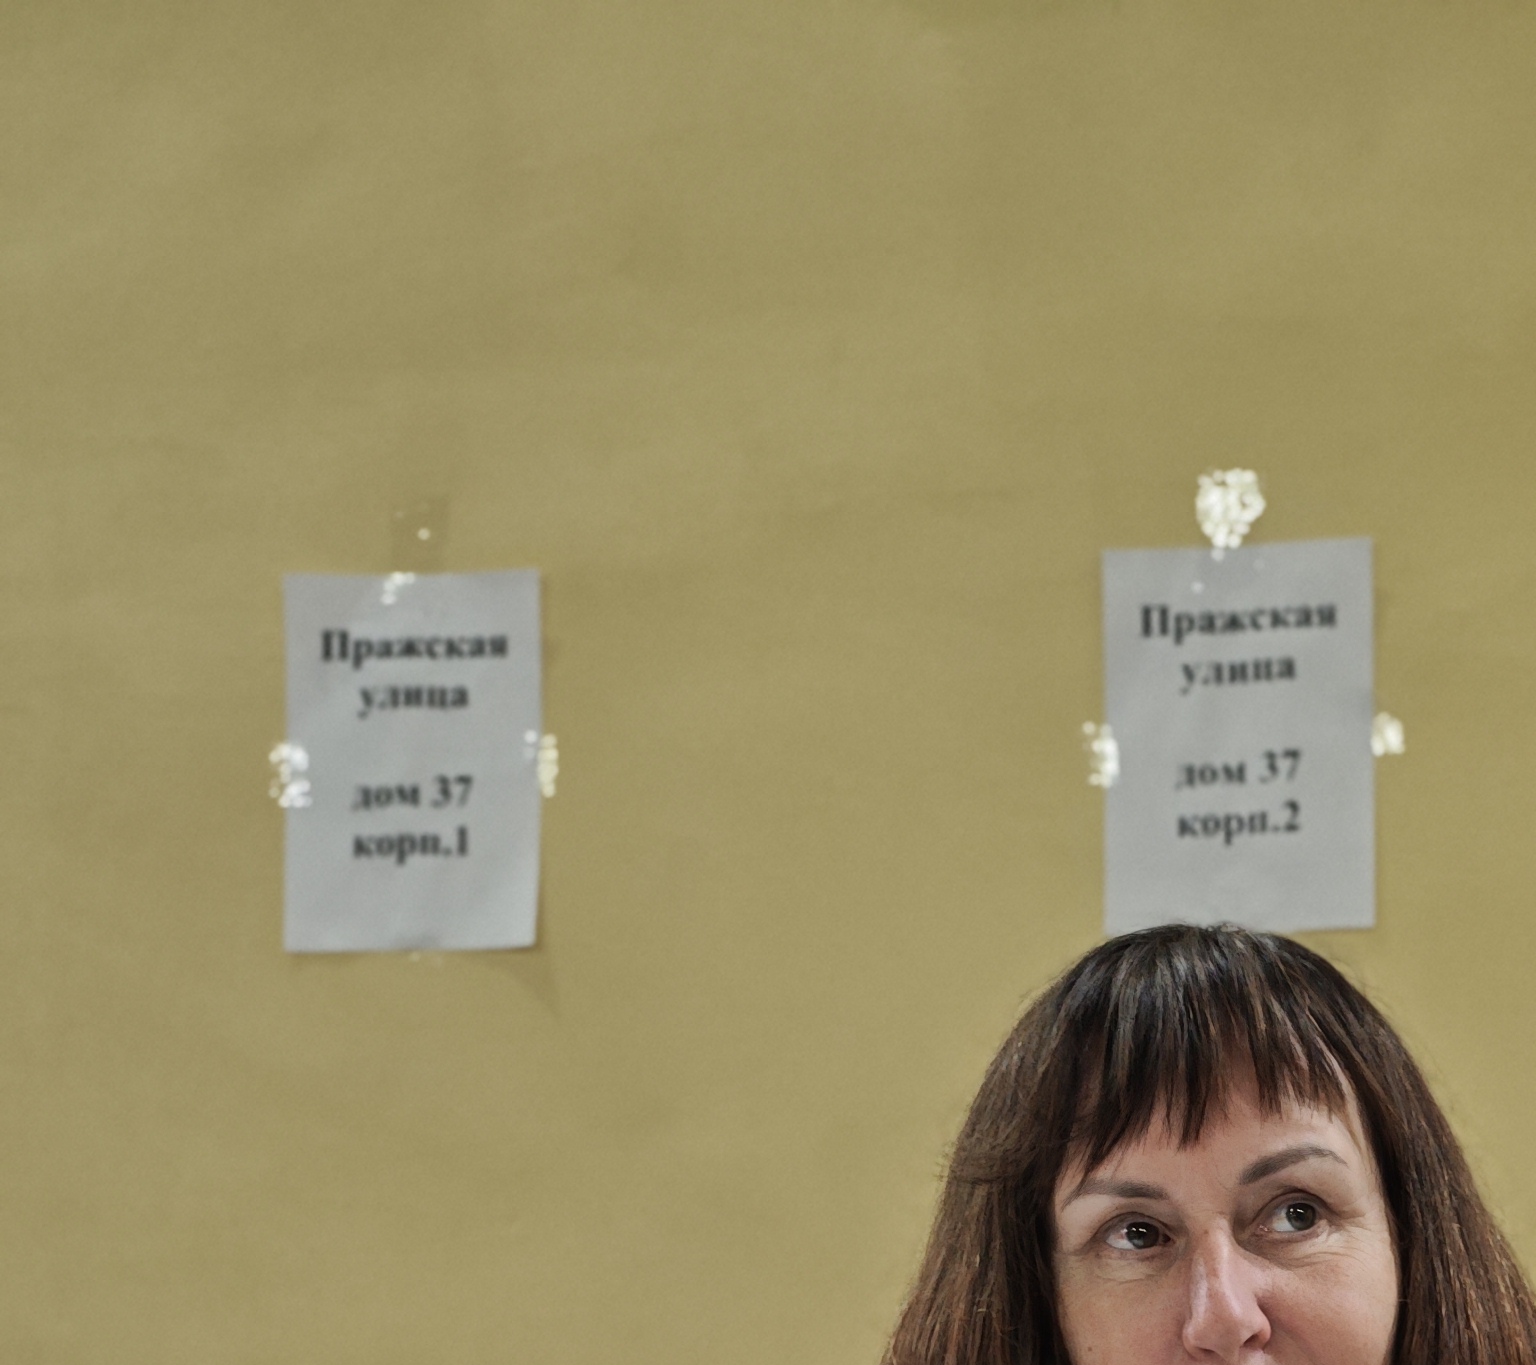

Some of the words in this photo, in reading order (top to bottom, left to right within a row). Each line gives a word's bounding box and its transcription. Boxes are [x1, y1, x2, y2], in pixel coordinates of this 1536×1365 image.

[1141, 603, 1338, 646] Пражская
[321, 629, 509, 671] Пражская
[1179, 657, 1297, 696] улица
[357, 684, 469, 720] улица
[1175, 761, 1246, 791] дом
[1259, 748, 1302, 784] 37
[352, 783, 420, 812] дом
[431, 774, 473, 808] 37
[1177, 799, 1301, 847] корп.2
[354, 825, 468, 866] корп.1
